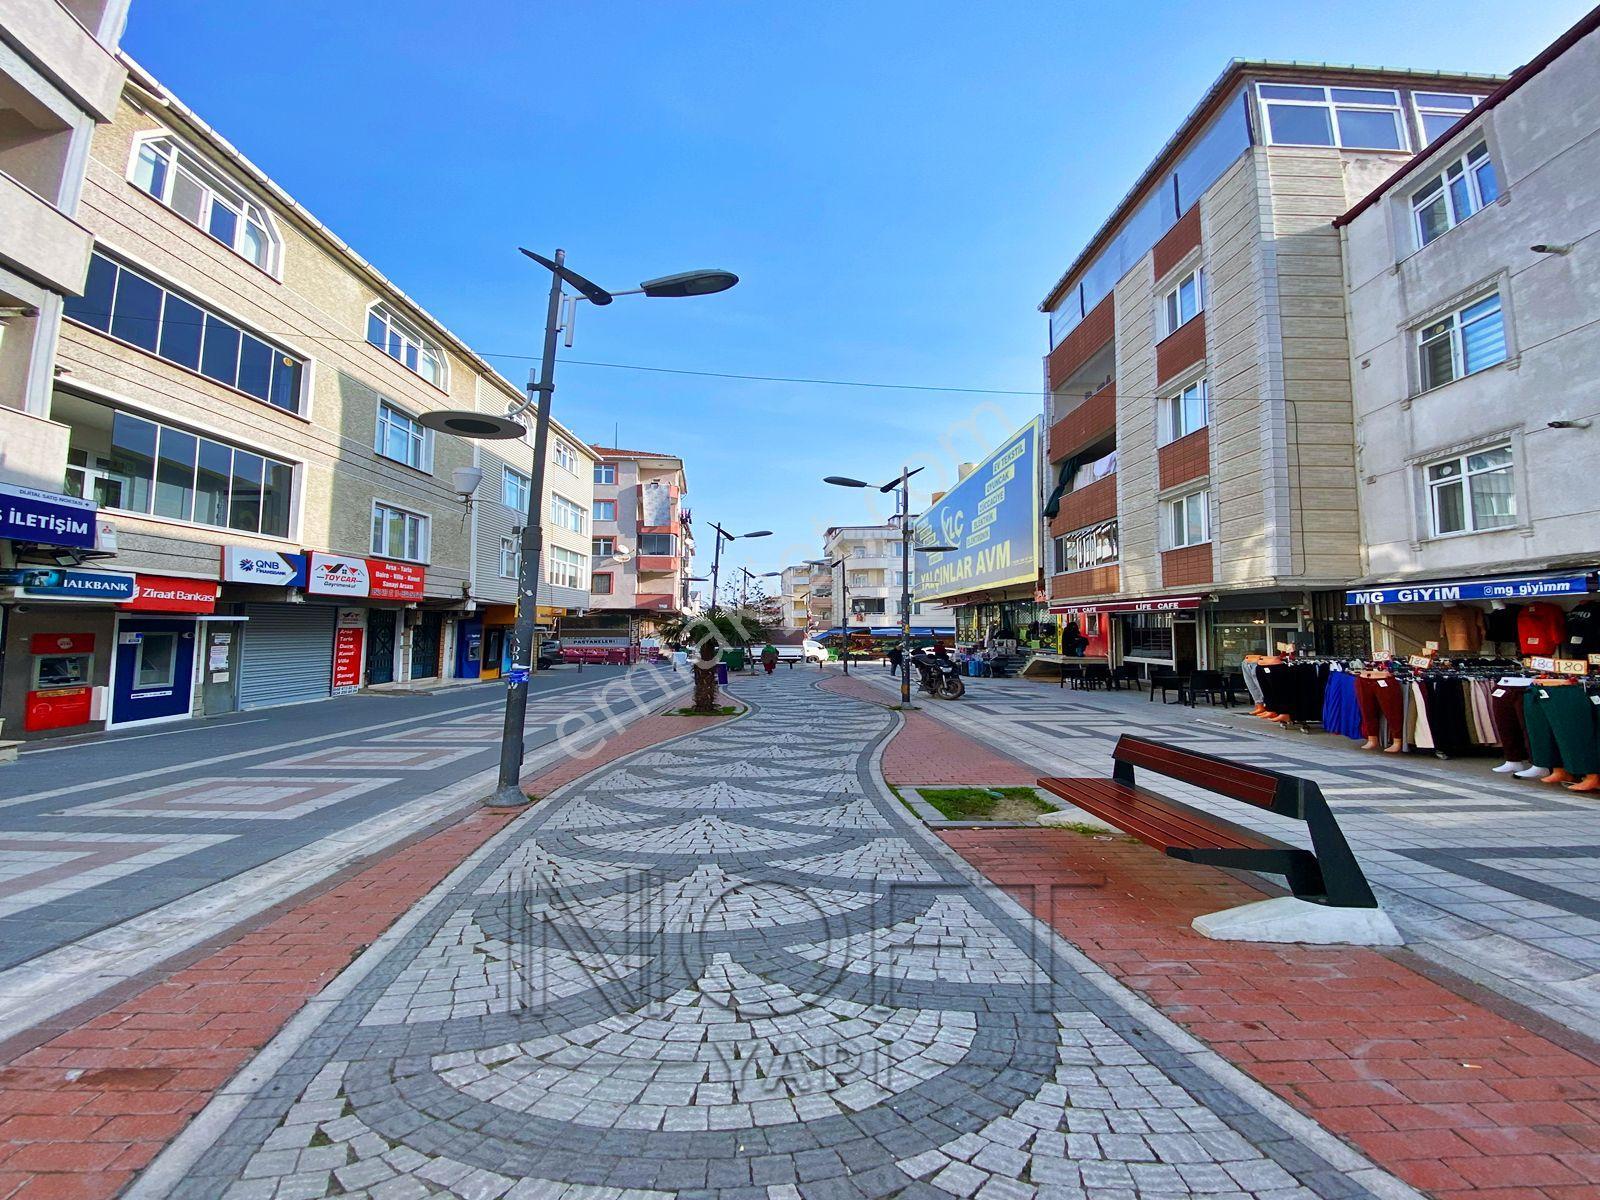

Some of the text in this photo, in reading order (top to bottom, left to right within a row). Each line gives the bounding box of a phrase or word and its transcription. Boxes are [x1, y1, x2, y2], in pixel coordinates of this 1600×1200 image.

[8, 507, 88, 535] İLETİŞİM
[976, 539, 1010, 576] AVM
[256, 560, 279, 570] QNB
[142, 587, 215, 602] Ziraat Bankası
[1355, 591, 1384, 604] MG
[1556, 661, 1584, 673] 180
